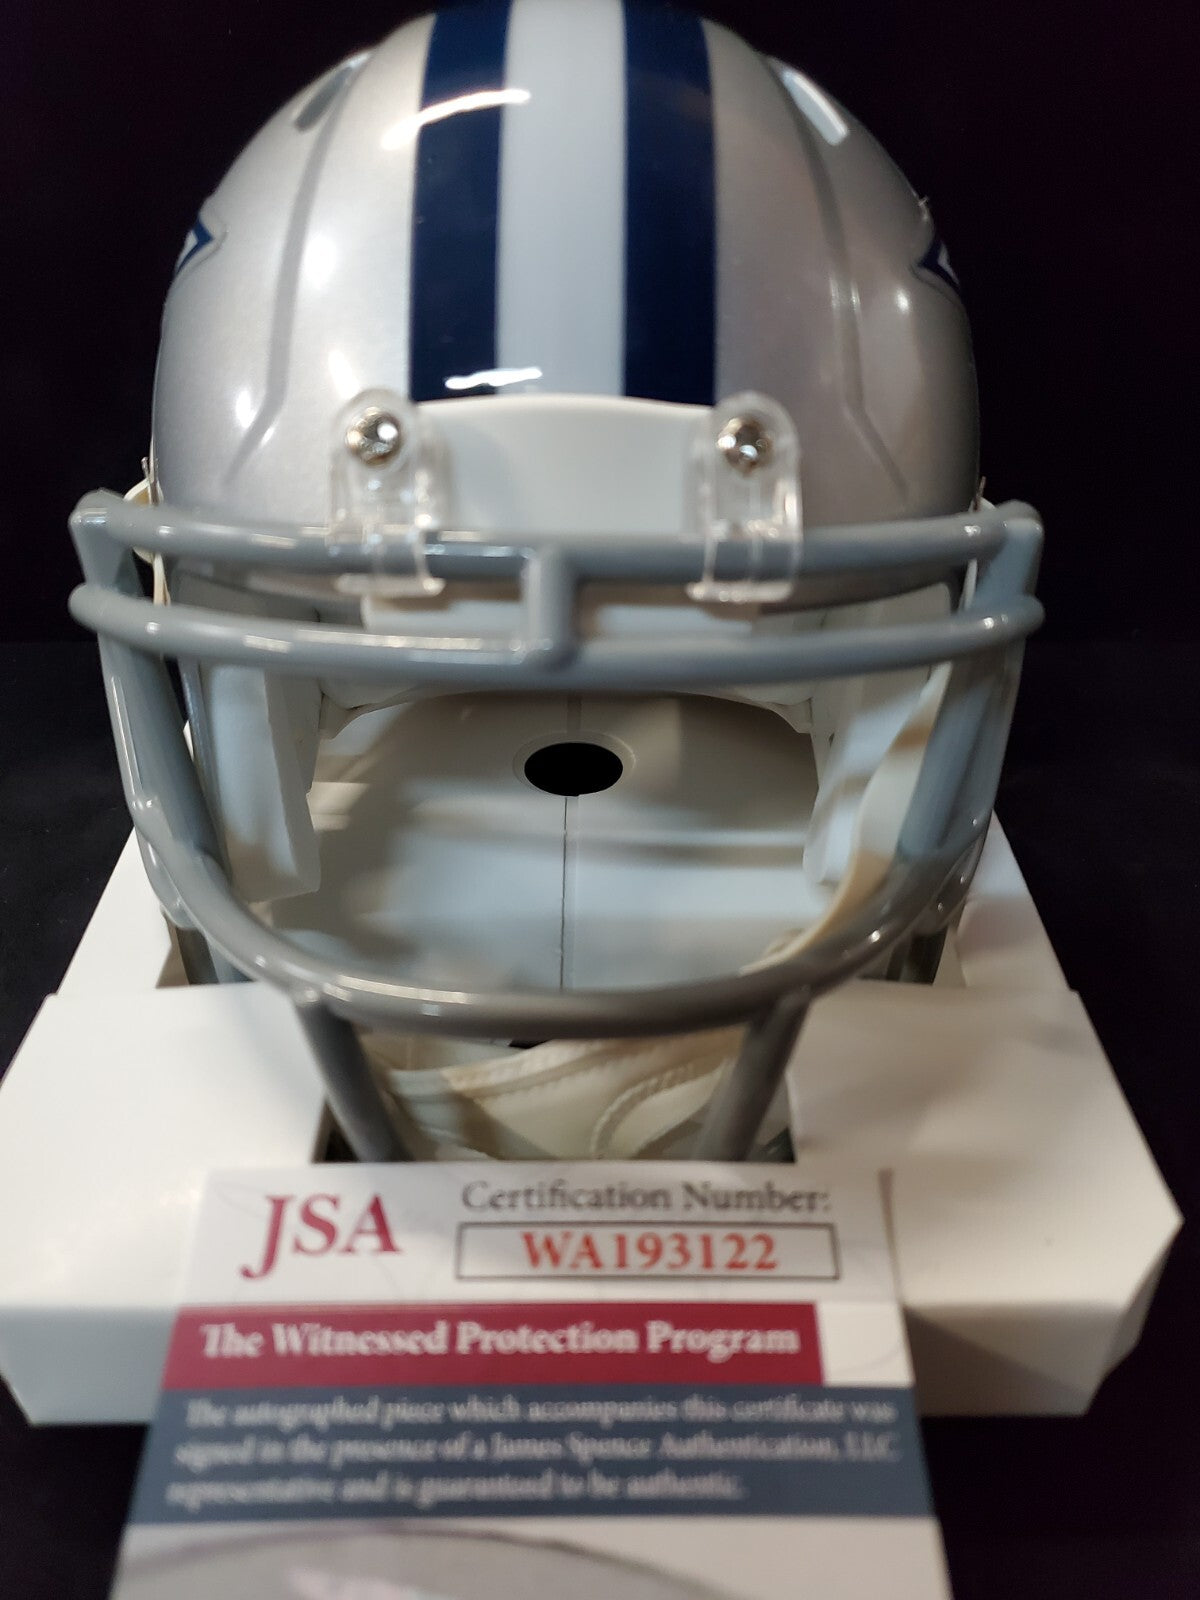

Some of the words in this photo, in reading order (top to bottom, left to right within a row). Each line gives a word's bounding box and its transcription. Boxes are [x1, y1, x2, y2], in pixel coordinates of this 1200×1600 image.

[460, 1179, 674, 1213] Certification
[681, 1180, 832, 1213] Number:
[240, 1193, 404, 1281] JSA
[522, 1230, 780, 1272] WA193122
[200, 1322, 264, 1358] The
[271, 1319, 448, 1356] Witnessed
[455, 1319, 641, 1355] Protection
[646, 1319, 801, 1364] Program
[449, 1394, 521, 1424] which
